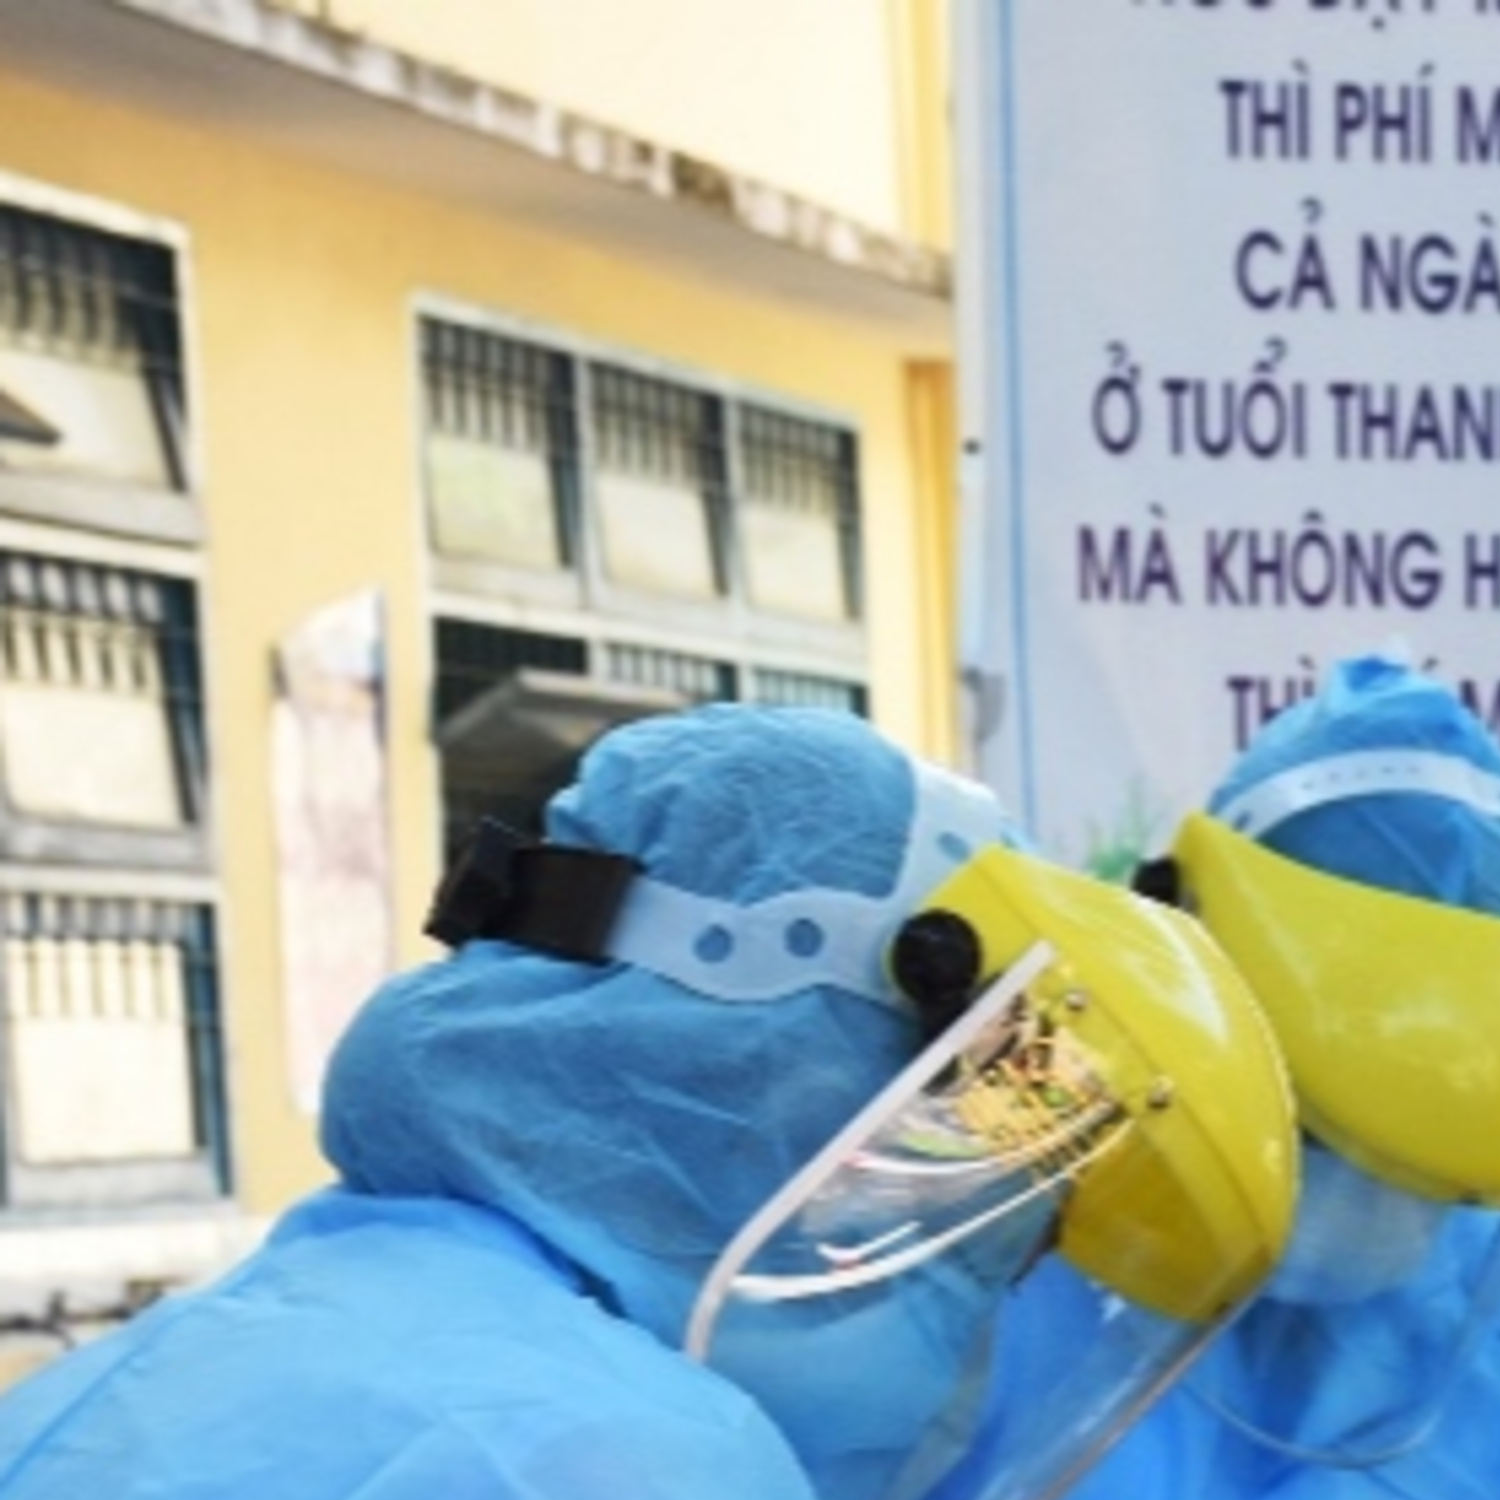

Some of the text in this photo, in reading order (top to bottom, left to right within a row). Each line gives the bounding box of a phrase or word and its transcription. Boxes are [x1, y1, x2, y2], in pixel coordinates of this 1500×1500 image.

[1218, 60, 1311, 160] THÌ
[1333, 63, 1434, 164] PHÍ
[1234, 197, 1337, 311] CẢ
[1091, 340, 1142, 457] Ở
[1160, 337, 1307, 461] TUỔI
[1077, 504, 1181, 605] MÀ
[1205, 509, 1444, 612] KHÔNG
